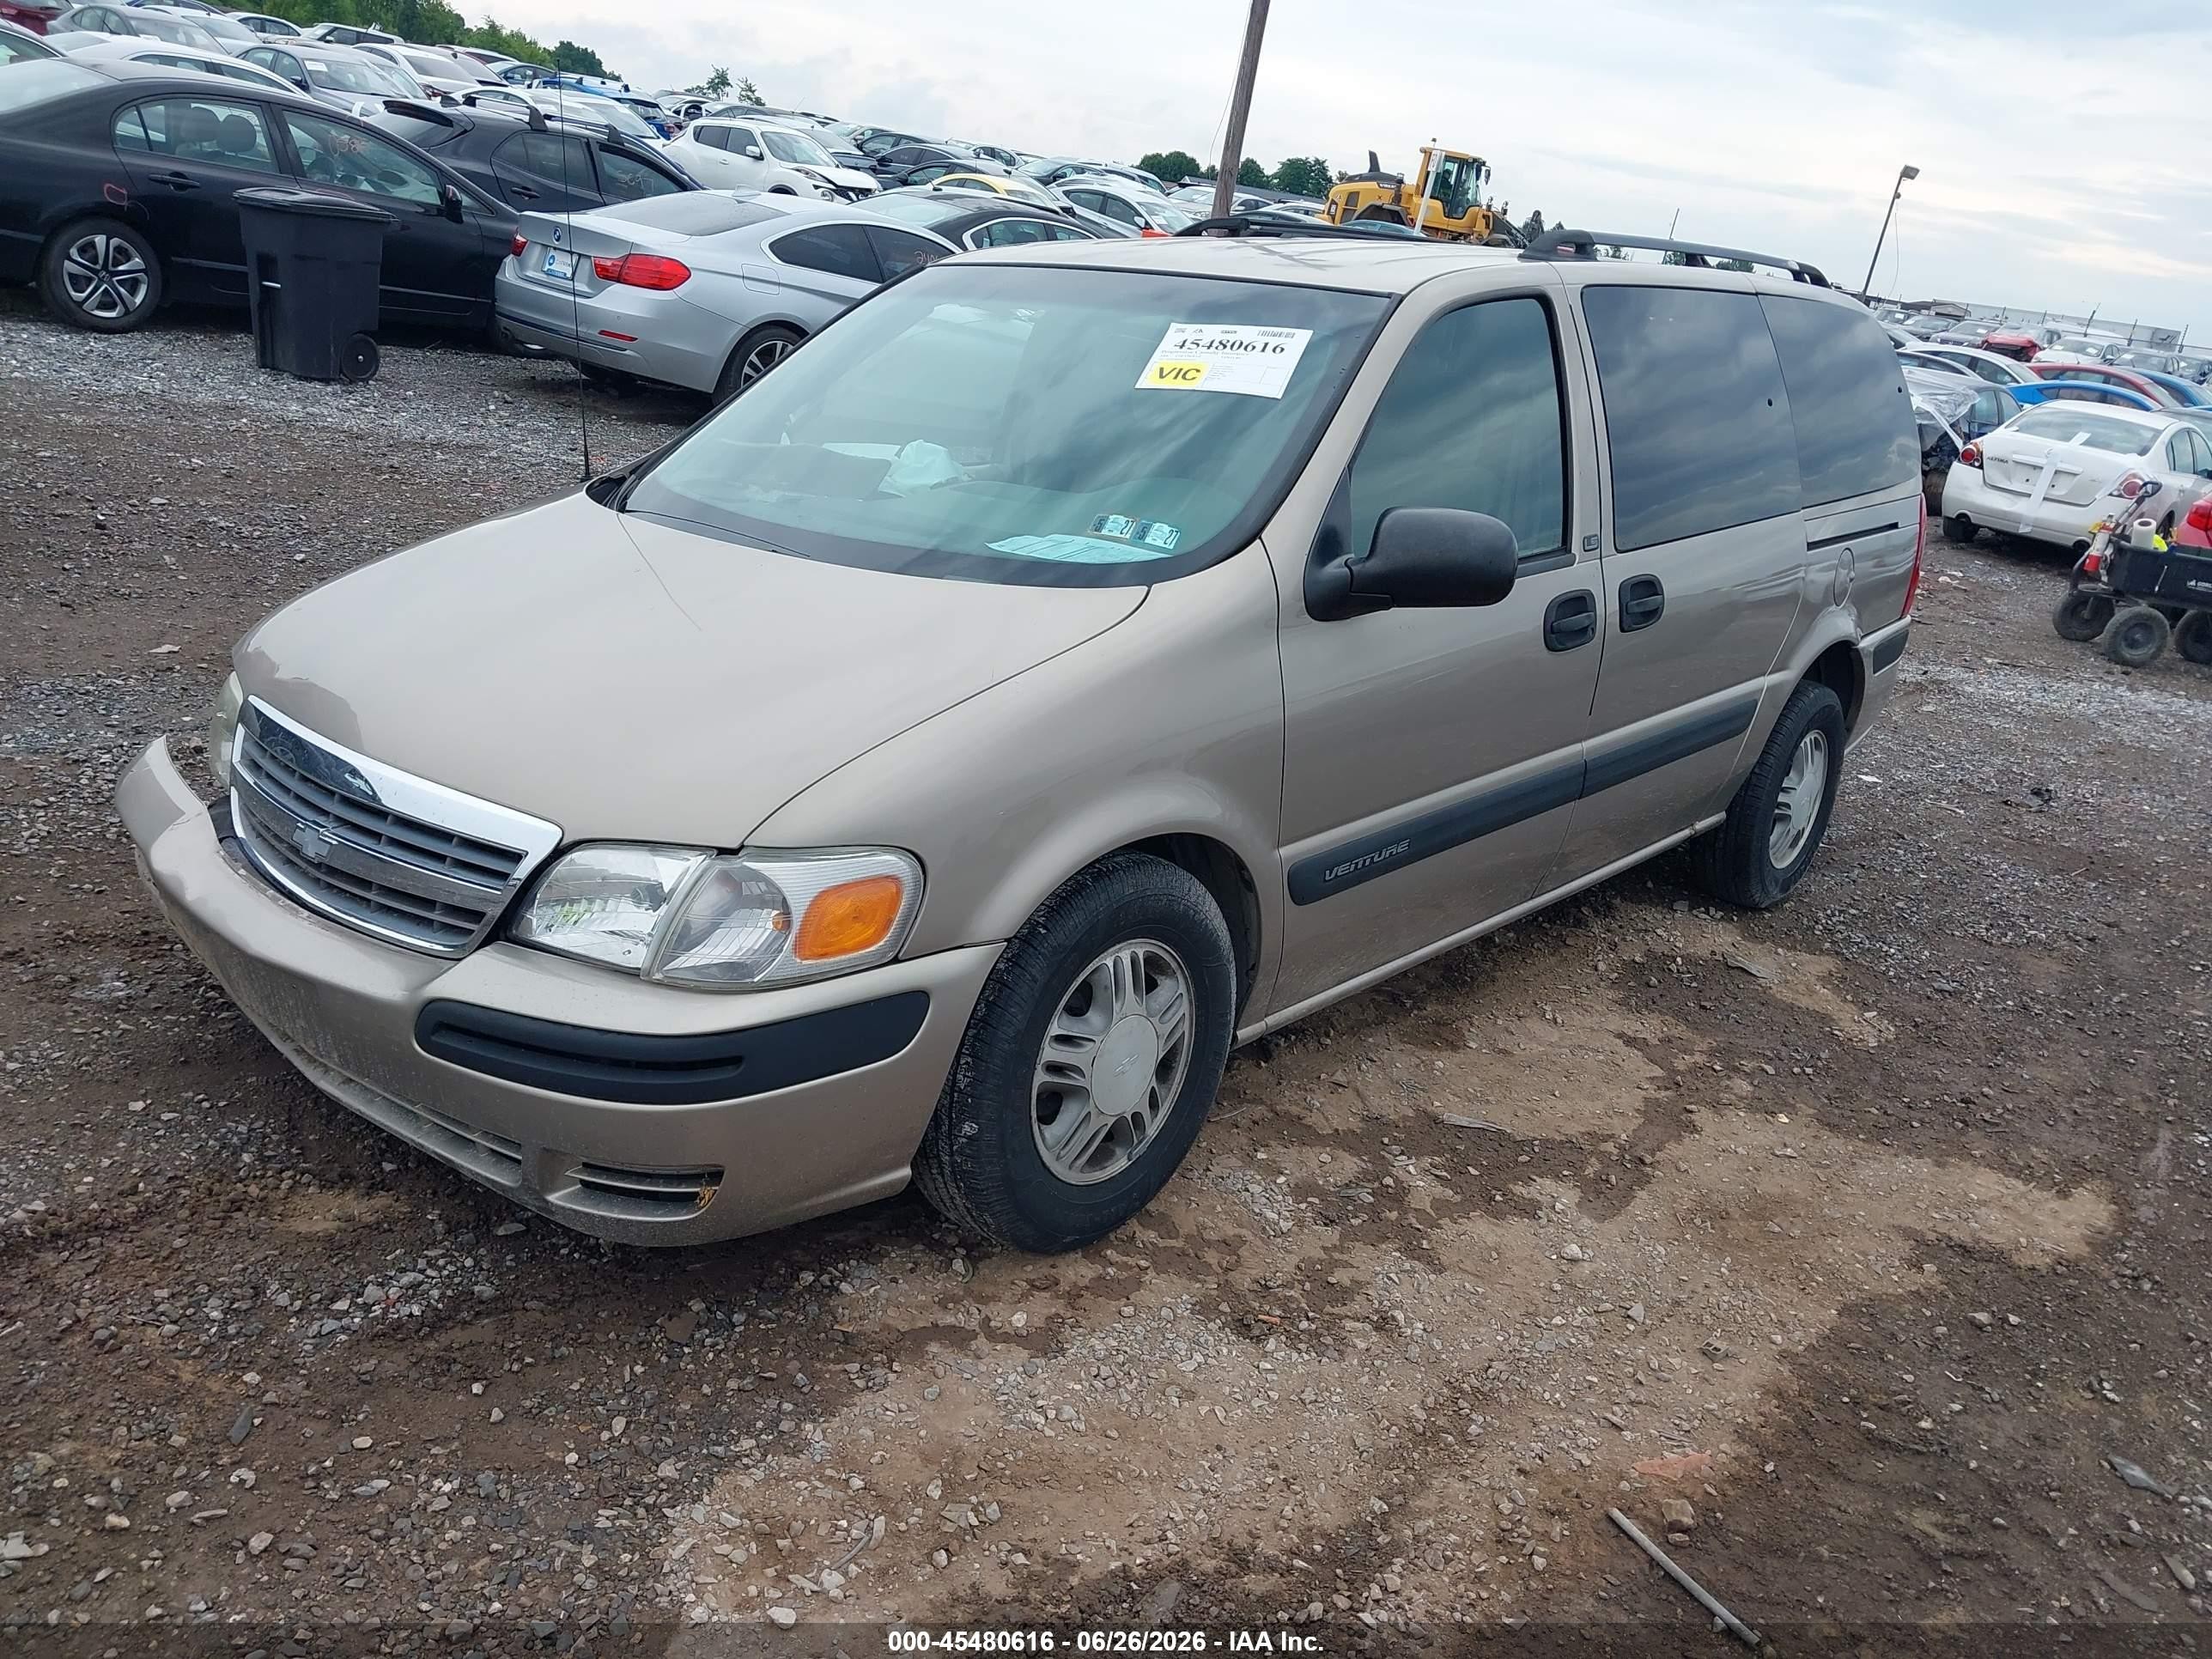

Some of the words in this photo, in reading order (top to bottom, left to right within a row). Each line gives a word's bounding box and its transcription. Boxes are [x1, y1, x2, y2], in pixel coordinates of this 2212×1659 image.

[1174, 338, 1285, 354] 45480616
[1158, 367, 1200, 381] VIC
[1120, 520, 1135, 537] 27
[1164, 529, 1179, 546] 27
[1325, 838, 1410, 881] VENTURE
